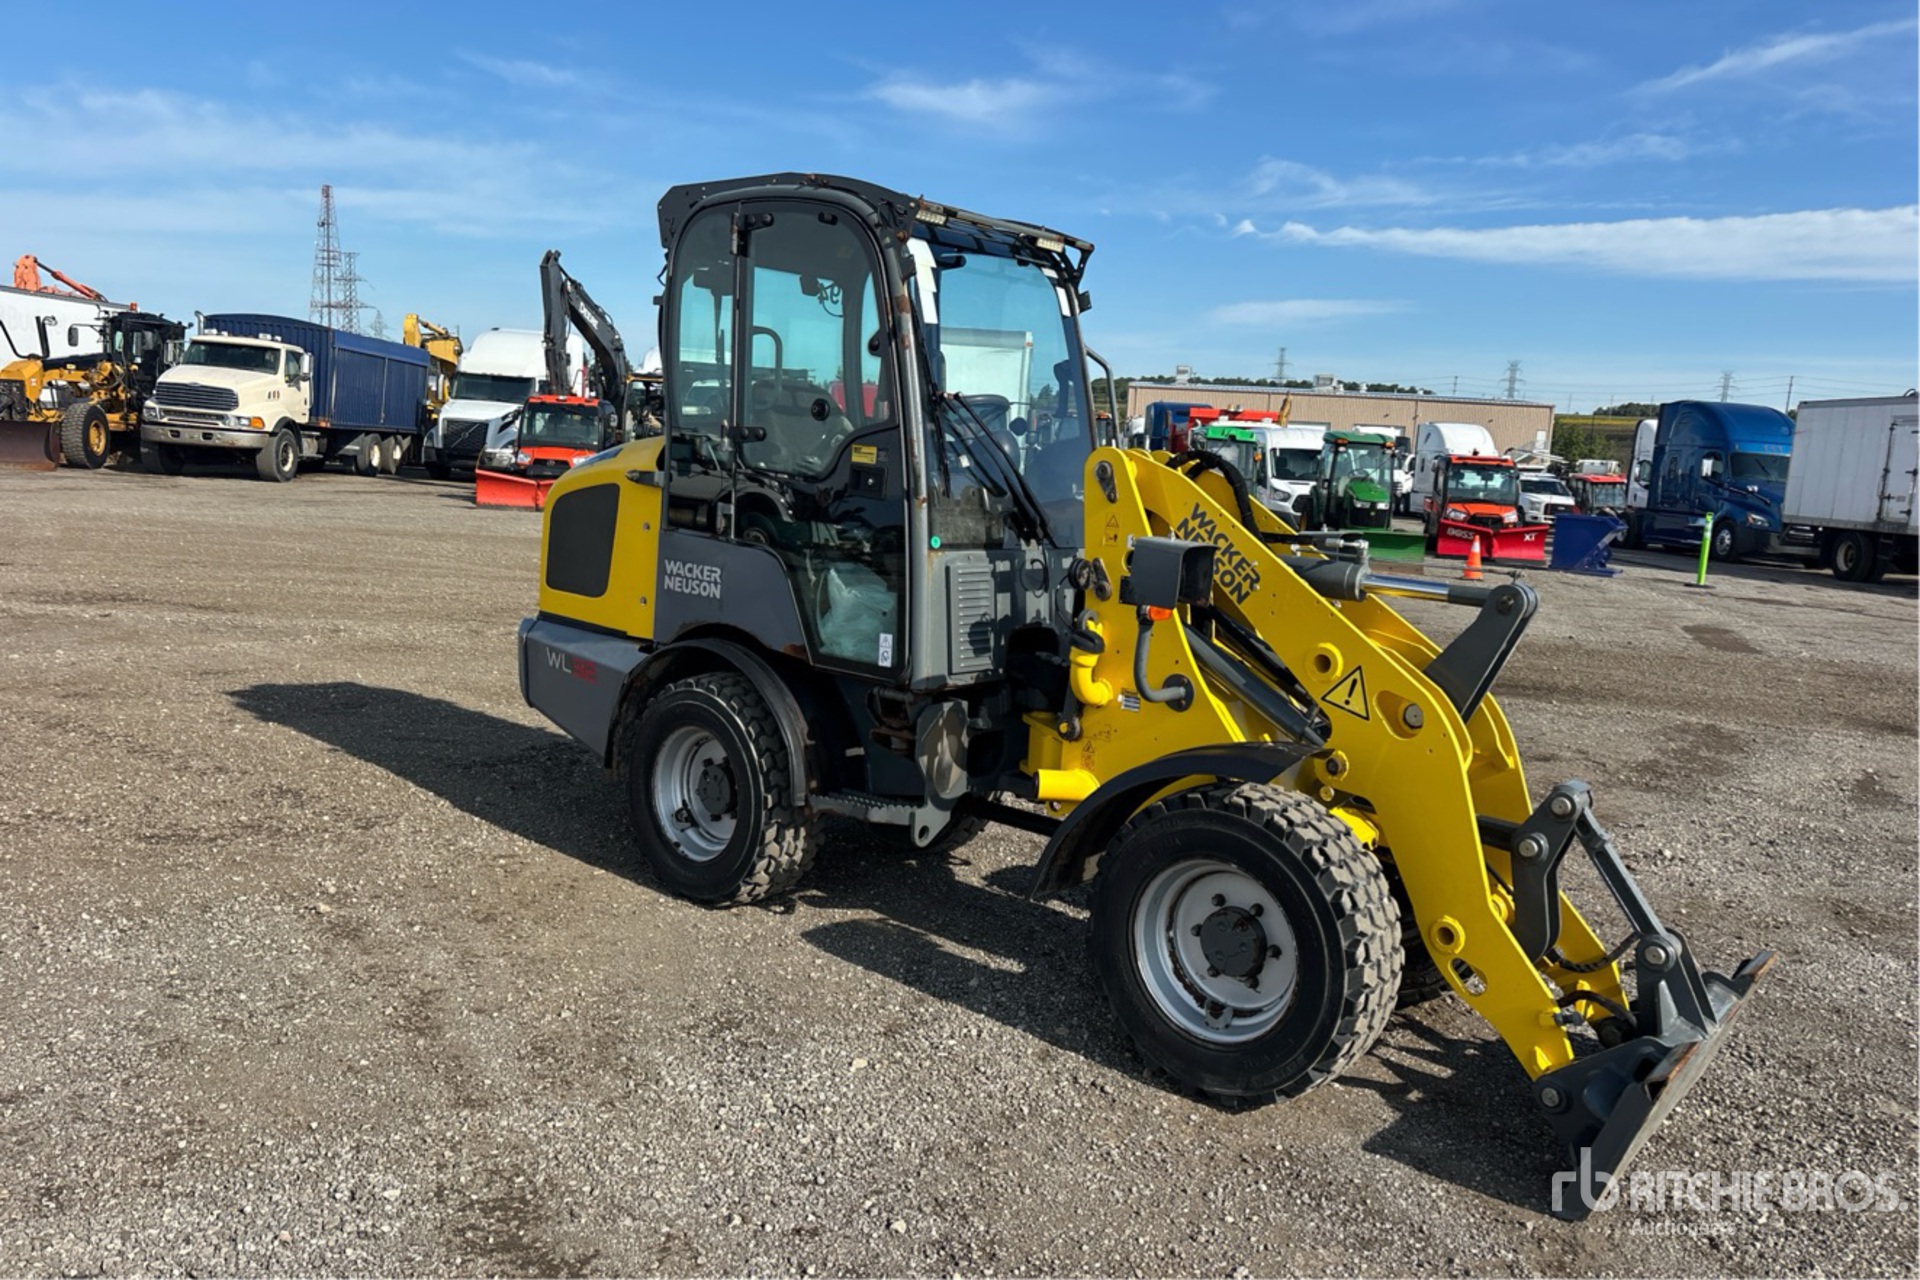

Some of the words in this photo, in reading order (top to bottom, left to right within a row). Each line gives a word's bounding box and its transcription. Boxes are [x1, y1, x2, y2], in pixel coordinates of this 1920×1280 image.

[664, 559, 722, 583] WACKER
[1176, 517, 1251, 605] NSON
[1190, 502, 1261, 592] WACKER
[664, 574, 721, 599] NEUSON
